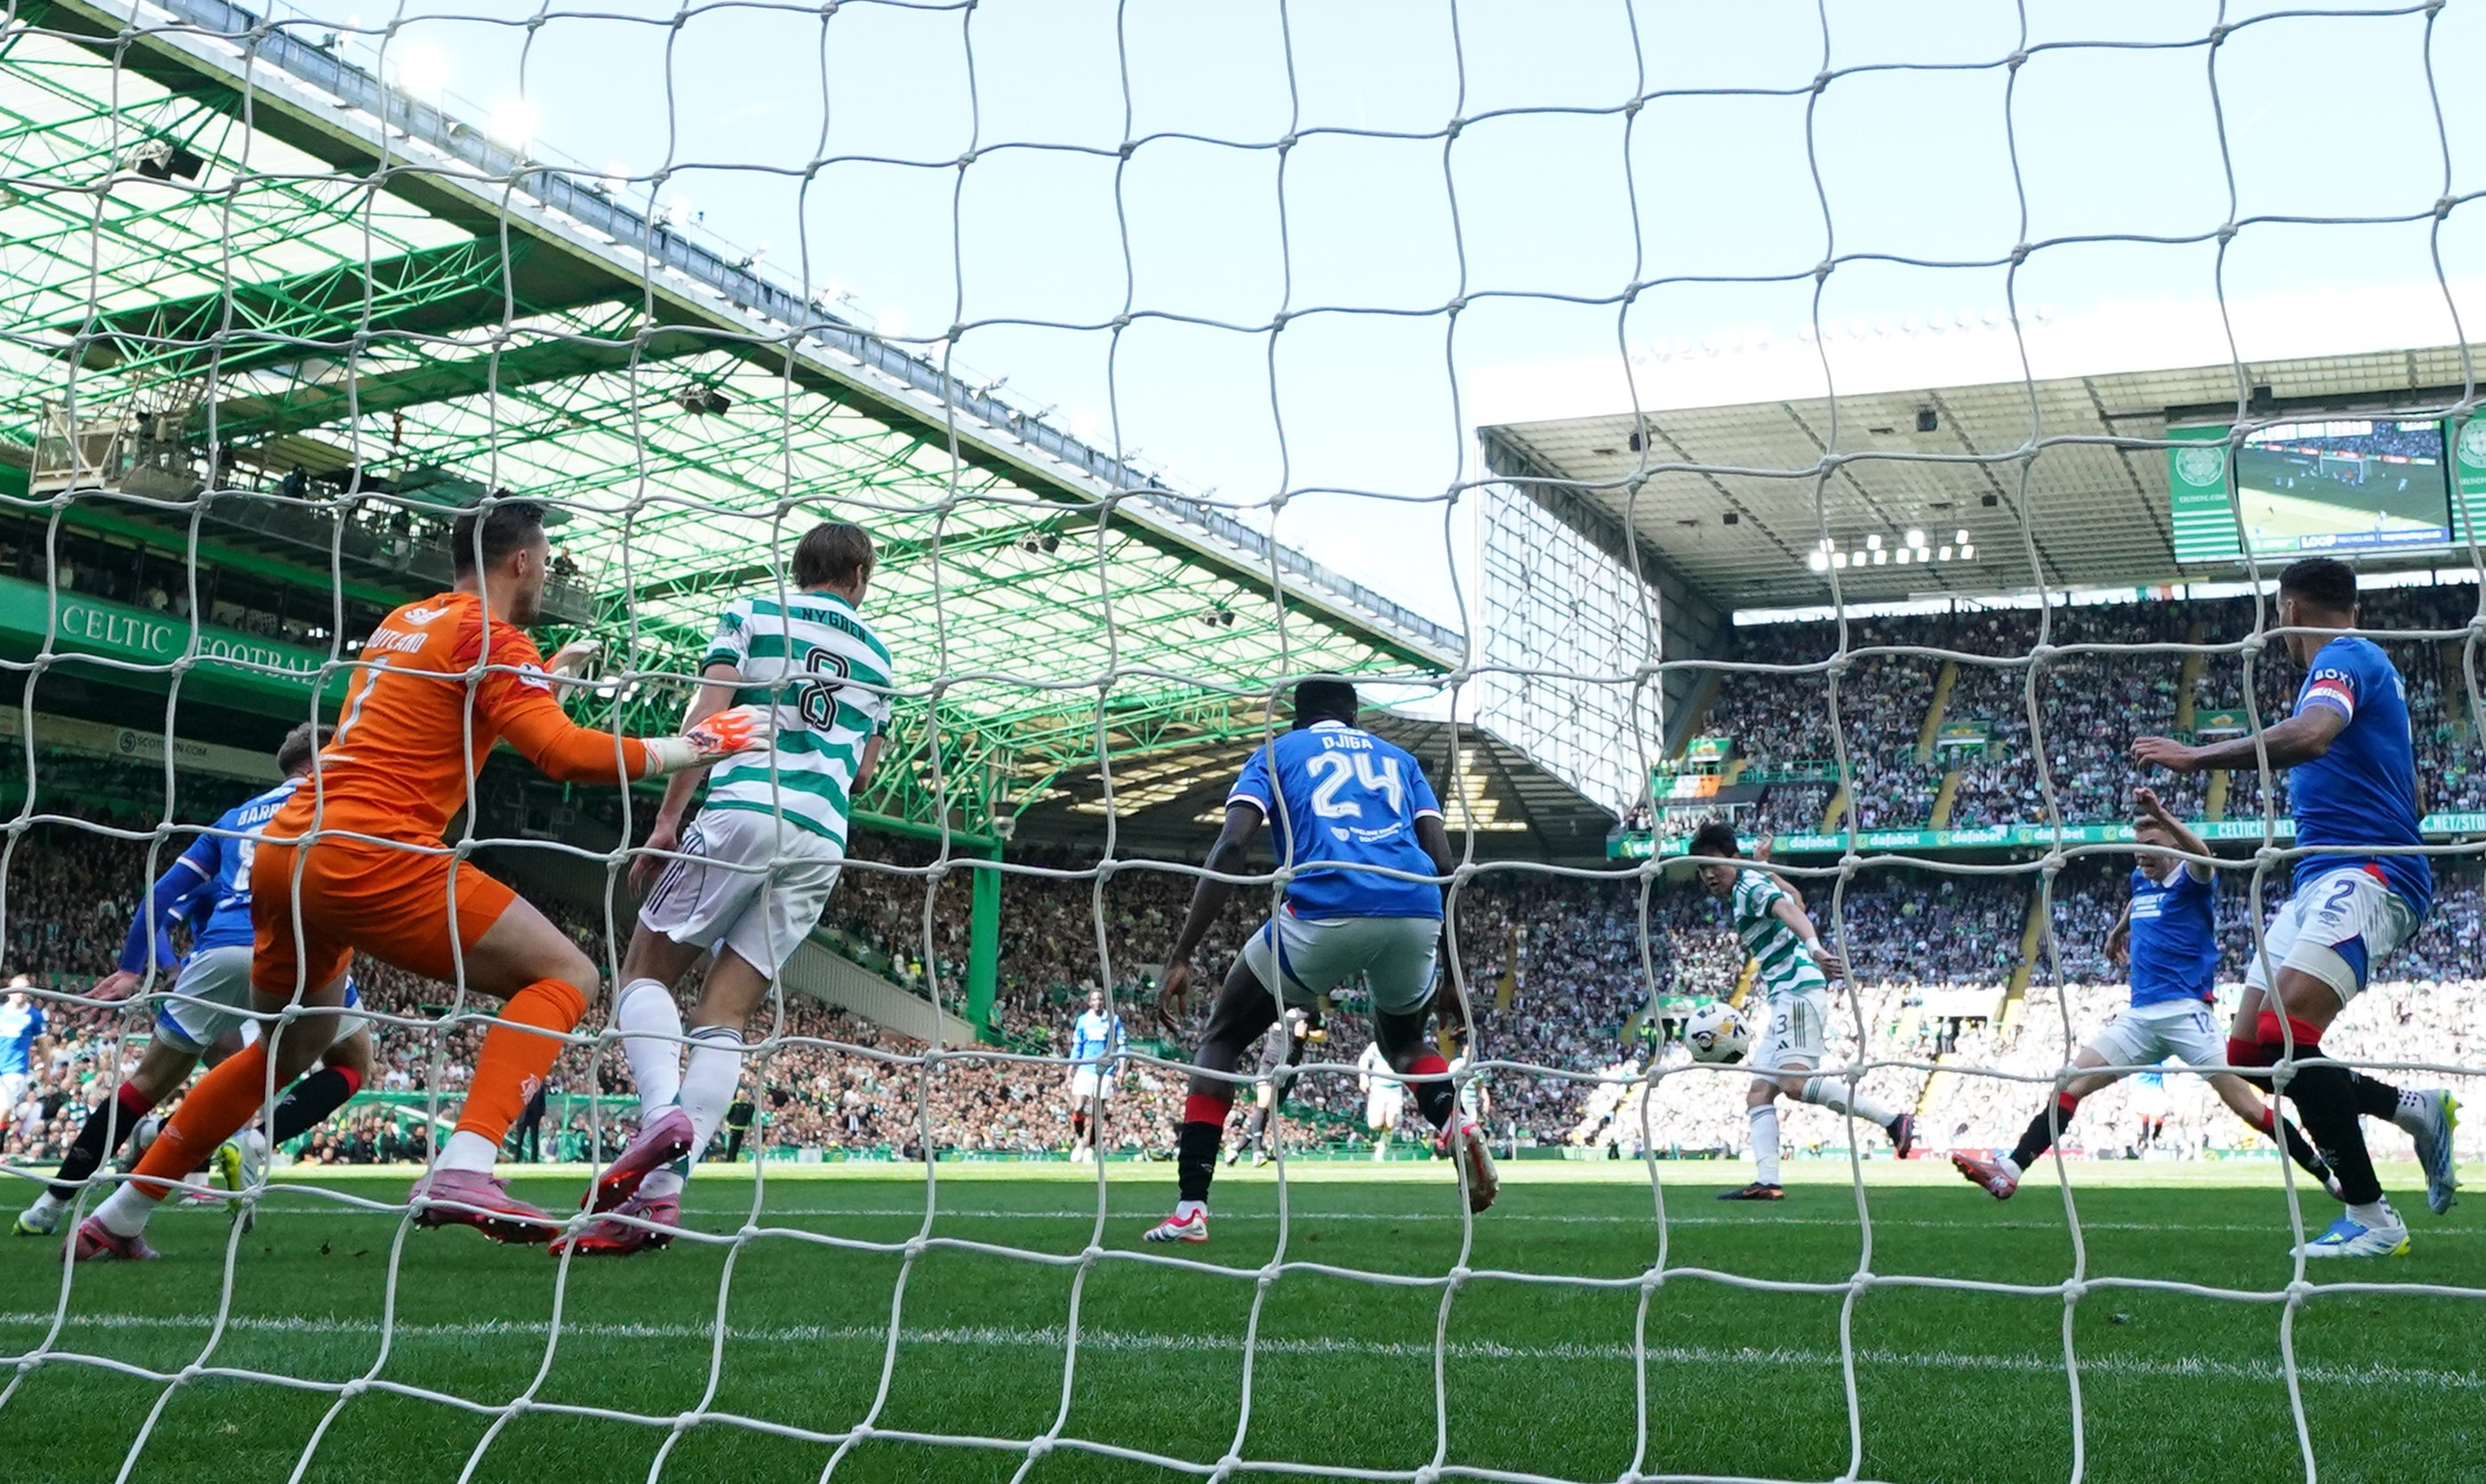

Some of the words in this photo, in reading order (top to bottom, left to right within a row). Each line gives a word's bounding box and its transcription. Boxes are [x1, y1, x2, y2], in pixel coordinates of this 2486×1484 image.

[62, 605, 172, 654] CELTIC
[803, 607, 866, 643] NYGREN
[337, 656, 390, 746] 1
[798, 646, 850, 733] 8
[1321, 734, 1374, 750] DJIGA
[1305, 750, 1403, 819] 24
[1789, 836, 1839, 850] dafabet
[1869, 832, 1920, 847] dafabet
[2033, 827, 2086, 842] dafbet
[2324, 878, 2355, 914] 2
[2191, 1011, 2215, 1034] 12
